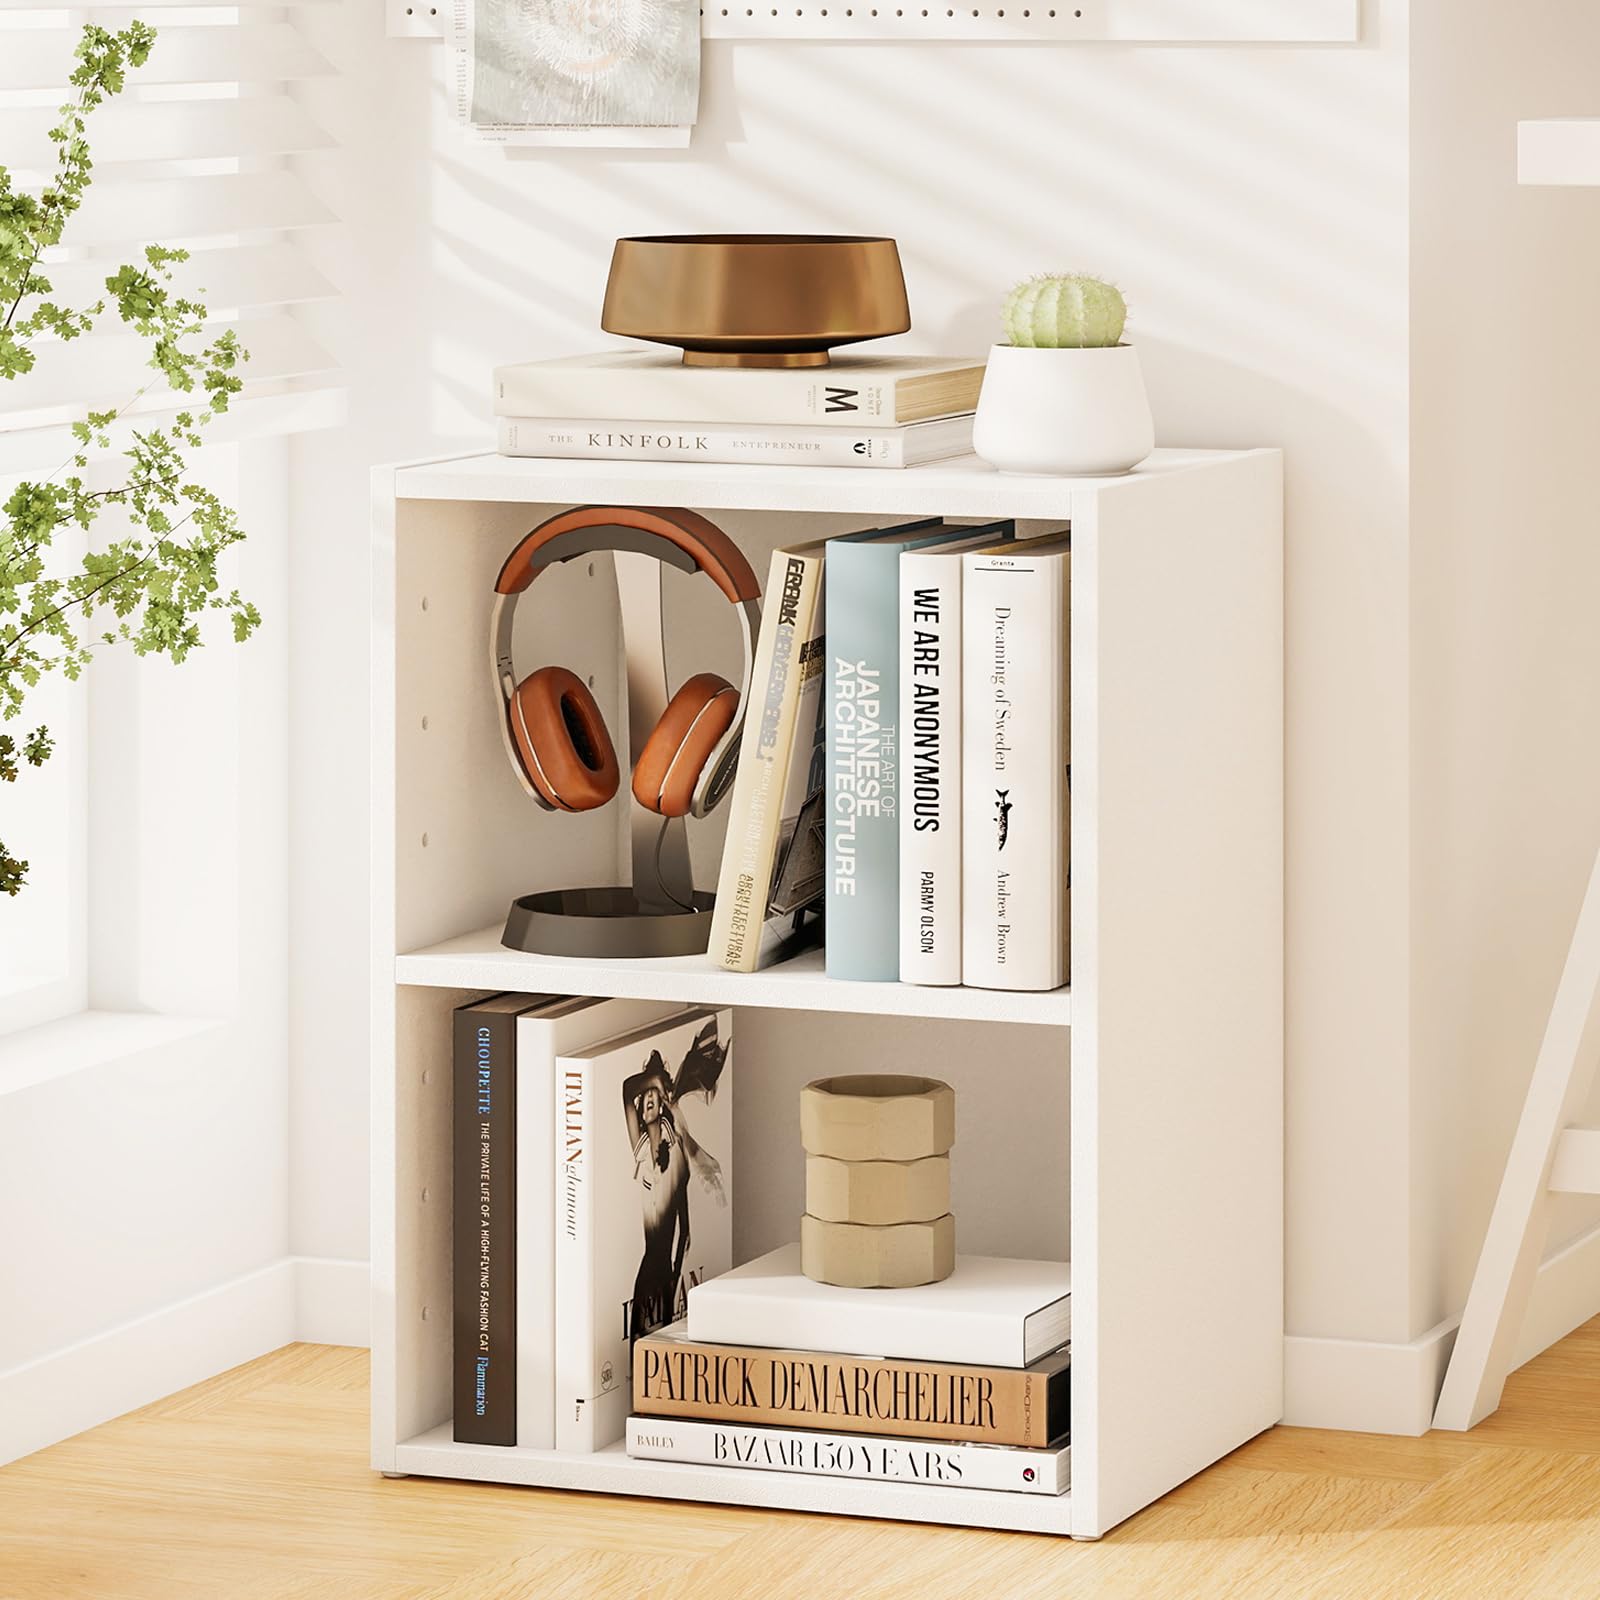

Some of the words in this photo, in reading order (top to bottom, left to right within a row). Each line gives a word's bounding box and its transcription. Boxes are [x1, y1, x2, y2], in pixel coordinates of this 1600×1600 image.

[825, 386, 858, 413] M
[549, 434, 573, 443] THE
[588, 433, 708, 450] KINFOLK
[732, 440, 821, 451] ENTEPRENEUR
[778, 557, 805, 626] FRANK
[914, 588, 939, 623] WE
[914, 630, 939, 676] ARE
[990, 608, 1011, 684] Dreaming
[995, 690, 1011, 706] of
[856, 660, 880, 817] JAPANESE
[881, 724, 895, 757] THE
[914, 683, 939, 832] ANONYMOUS
[995, 710, 1011, 770] Sweden
[835, 657, 856, 896] ARCHITECTURE
[881, 759, 895, 792] ART
[881, 795, 895, 818] OF
[920, 871, 934, 913] PARMY
[997, 870, 1010, 918] Andrew
[725, 874, 746, 965] CONSTRUCTIONS
[733, 875, 754, 966] ARCHITECTURAL
[920, 915, 934, 954] OLSON
[997, 923, 1010, 964] Brown
[478, 1027, 490, 1114] CHOUPETTE
[481, 1122, 490, 1139] THE
[565, 1072, 582, 1163] ITALIAN
[481, 1141, 490, 1180] PRIVATE
[481, 1182, 490, 1203] LIFE
[481, 1205, 490, 1217] OF
[563, 1163, 582, 1240] glamour
[481, 1219, 489, 1228] A
[480, 1230, 490, 1288] HIGH-FLYING
[480, 1290, 489, 1331] FASHION
[480, 1333, 489, 1352] CAT
[476, 1356, 488, 1416] Flammarion
[642, 1349, 760, 1408] PATRICK
[769, 1360, 997, 1429] DEMARCHELIER
[637, 1434, 675, 1449] BAILEY
[714, 1432, 803, 1467] BAZAAR
[814, 1441, 854, 1472] 150
[861, 1446, 962, 1481] YEARS
